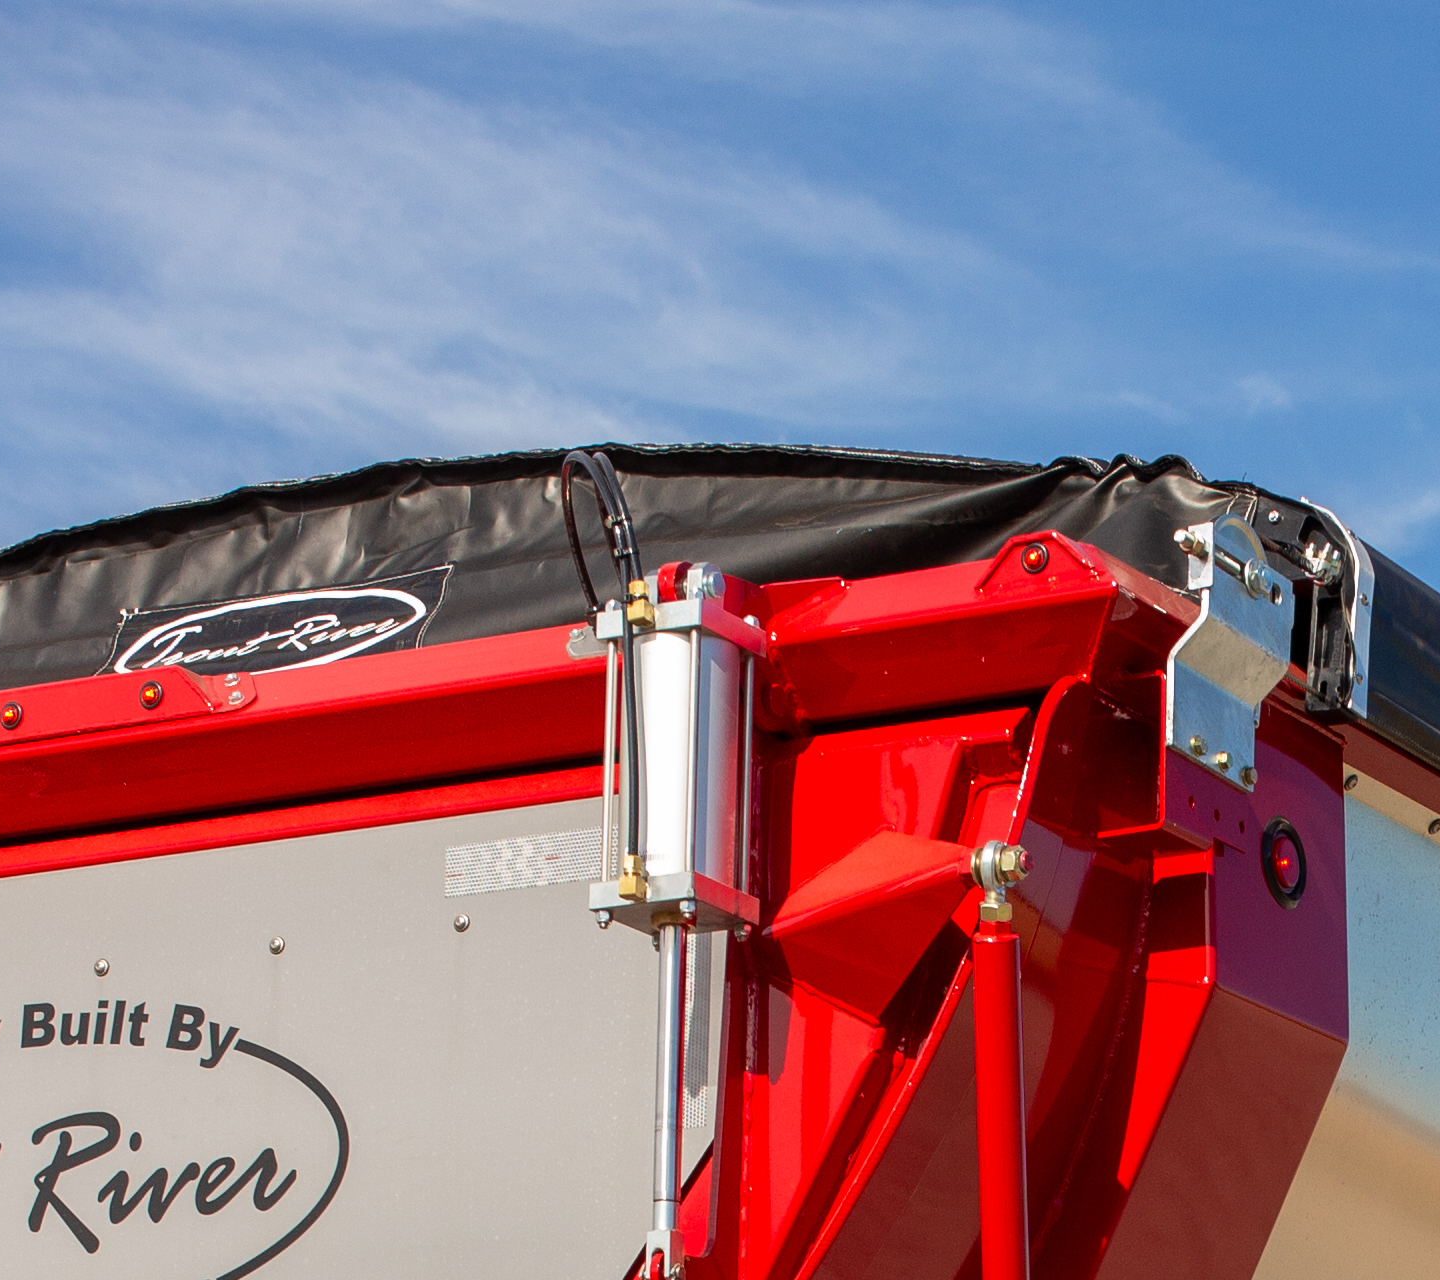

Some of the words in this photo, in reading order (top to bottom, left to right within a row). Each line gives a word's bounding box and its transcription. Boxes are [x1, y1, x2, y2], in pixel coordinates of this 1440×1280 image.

[145, 625, 277, 667] Trout
[276, 612, 402, 655] River
[19, 1000, 148, 1048] Built
[166, 1005, 239, 1069] By
[27, 1111, 298, 1253] River
